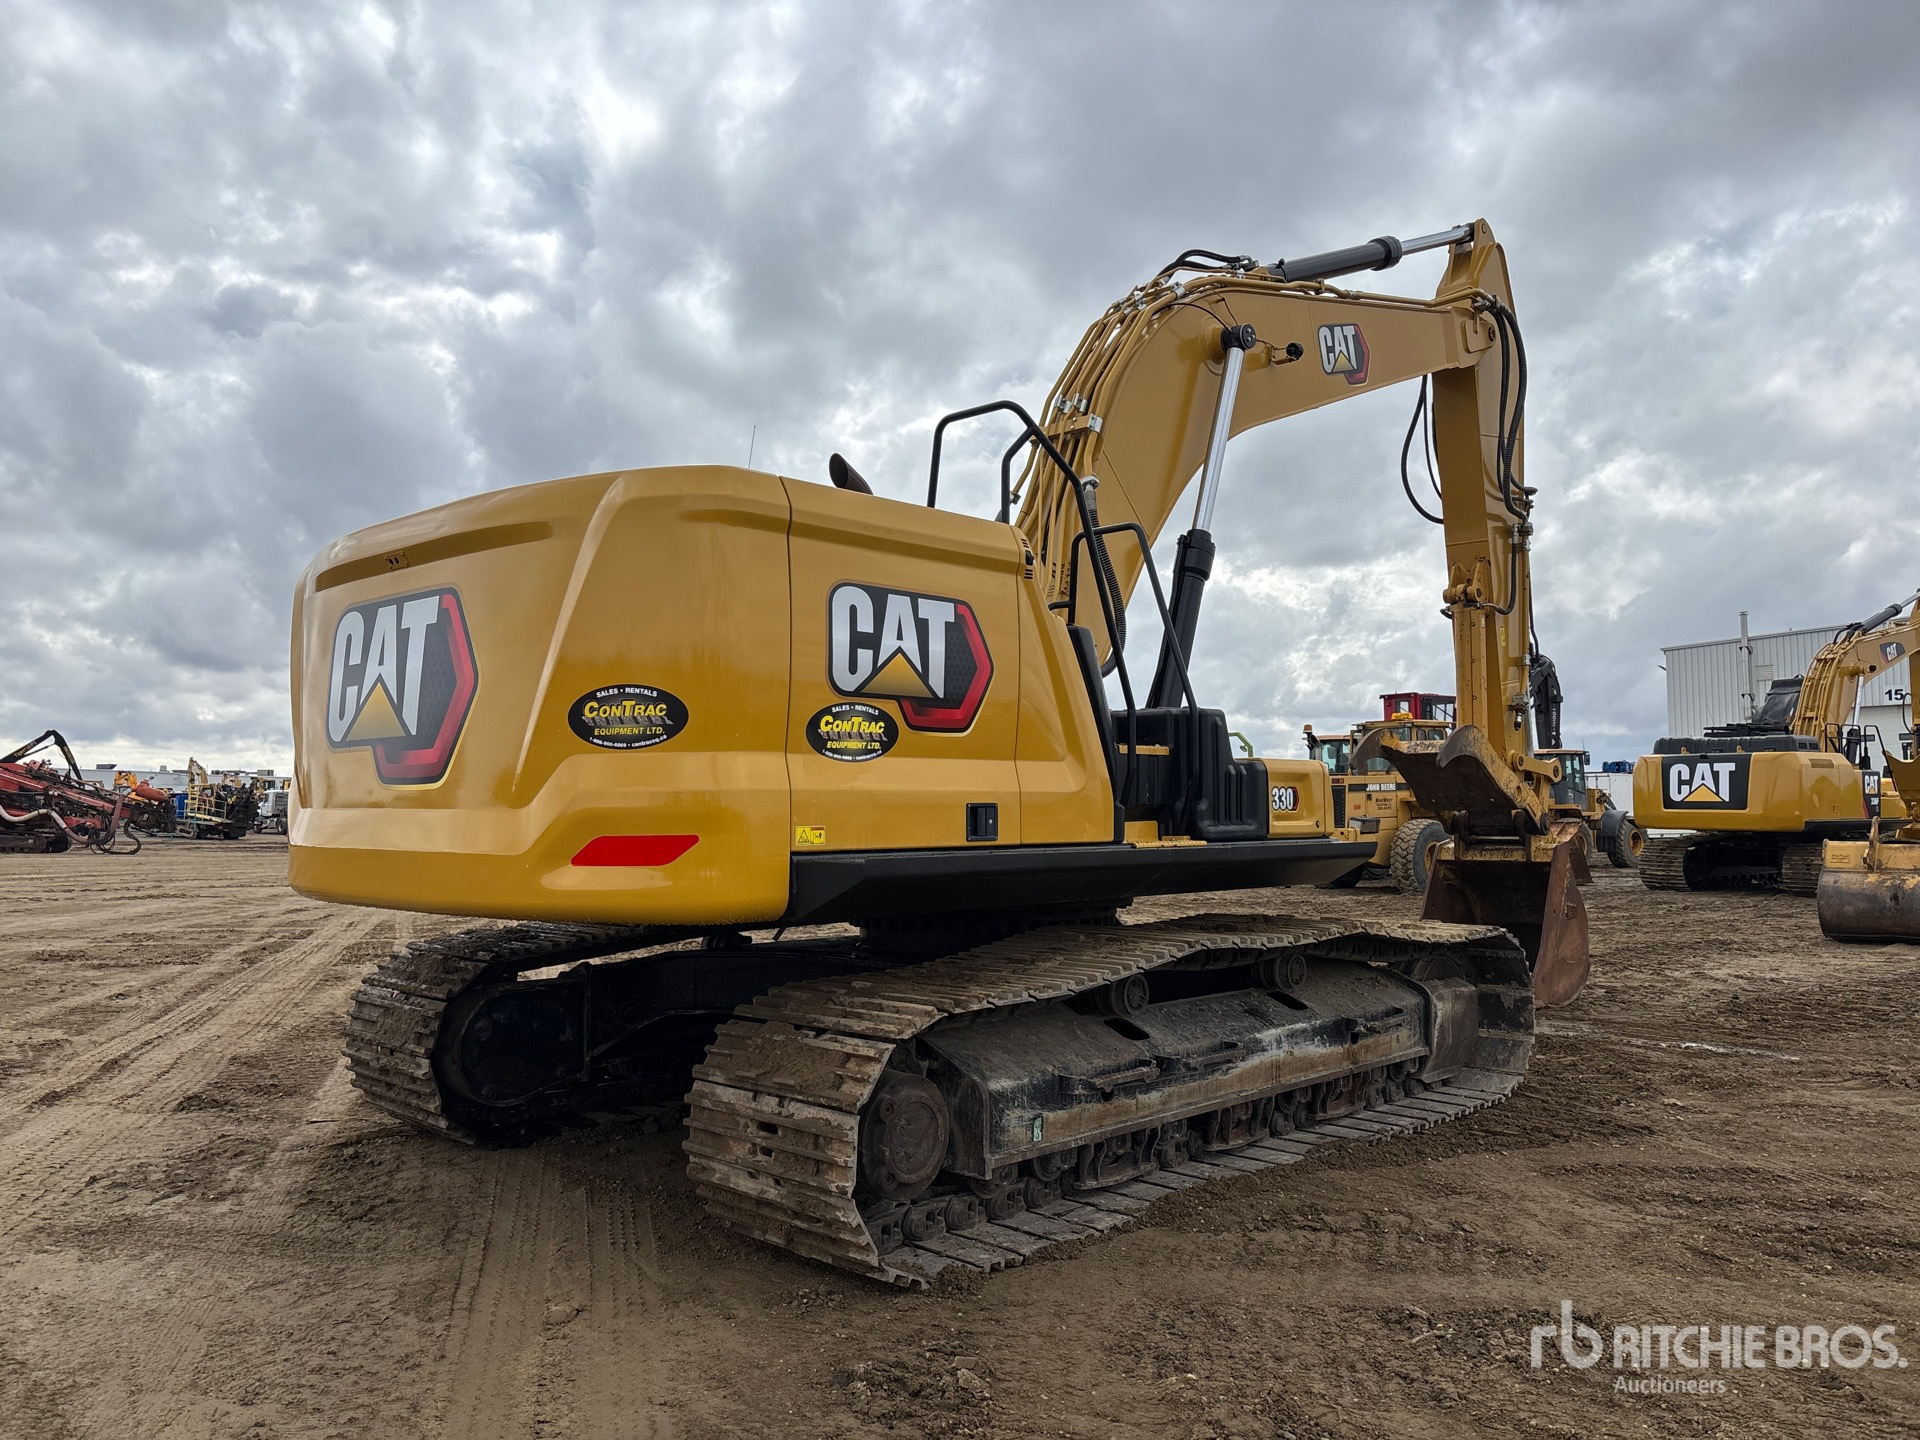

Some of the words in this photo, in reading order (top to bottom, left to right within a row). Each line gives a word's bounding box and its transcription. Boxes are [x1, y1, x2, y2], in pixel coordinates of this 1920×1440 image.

[1319, 324, 1358, 375] CAT
[832, 585, 955, 699] CAT
[1886, 643, 1898, 661] CAT
[330, 595, 440, 742] CAT
[596, 688, 618, 698] SALES
[625, 687, 658, 697] RENTALS
[1885, 688, 1904, 701] 15
[832, 704, 850, 713] SALES
[854, 704, 879, 716] RENTALS
[594, 727, 645, 736] EQUIPMENT
[646, 726, 665, 735] LTD.
[826, 741, 867, 749] EQUIPMENT
[867, 741, 882, 750] LTD.
[1365, 783, 1380, 791] JOHN
[1380, 783, 1396, 791] DEERE
[1669, 762, 1736, 803] CAT
[1864, 774, 1879, 794] CAT
[1272, 786, 1293, 811] 330
